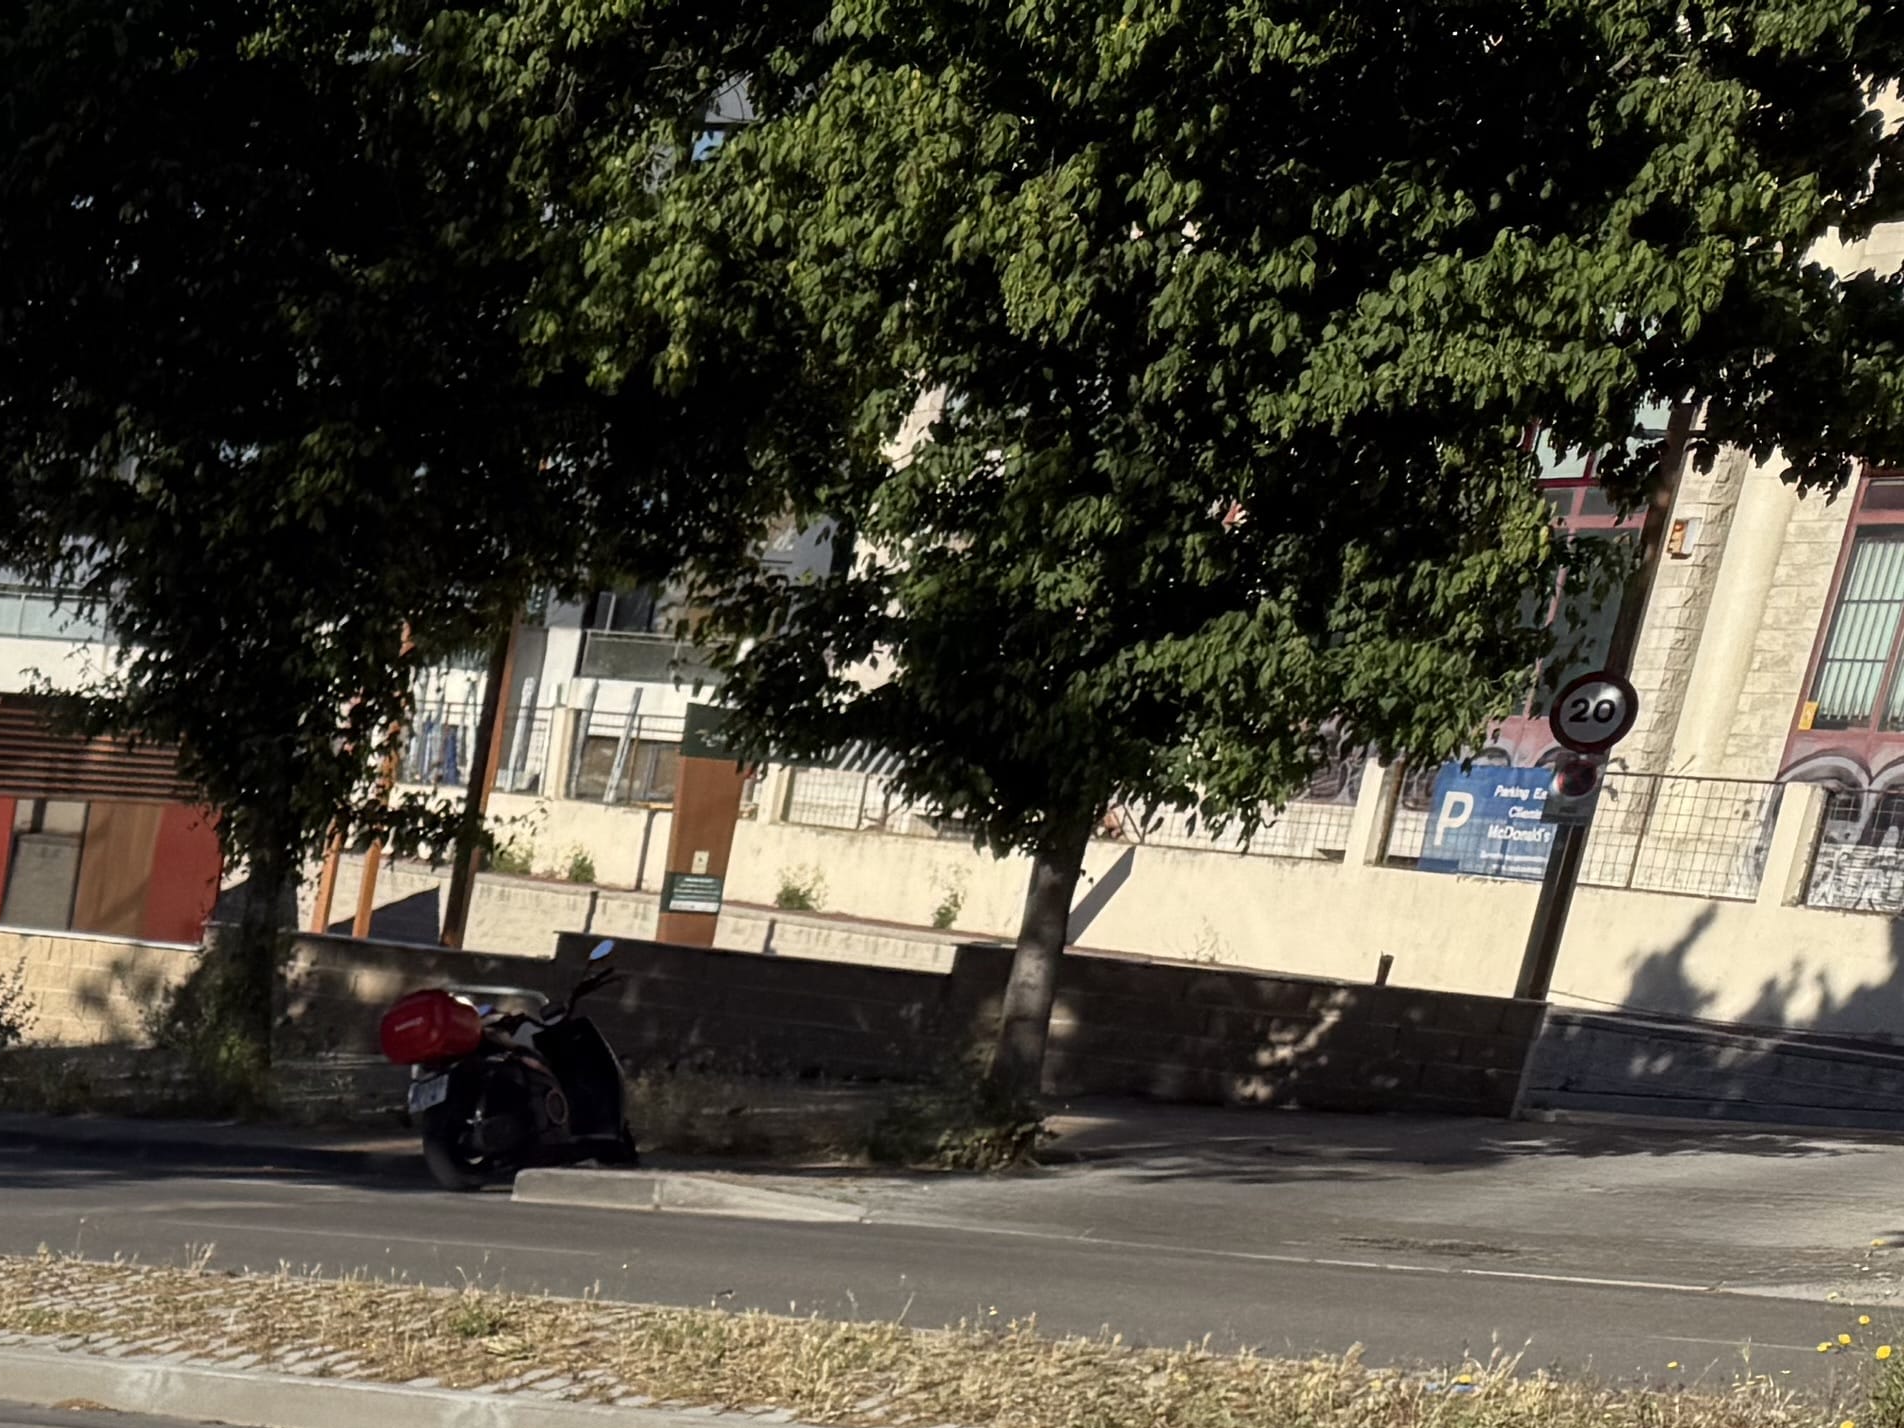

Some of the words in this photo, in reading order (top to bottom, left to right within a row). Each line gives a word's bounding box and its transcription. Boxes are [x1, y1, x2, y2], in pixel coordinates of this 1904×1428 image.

[1568, 697, 1616, 723] 20
[1494, 785, 1530, 800] Parking
[1434, 790, 1474, 846] P
[1488, 824, 1552, 843] McDonald's
